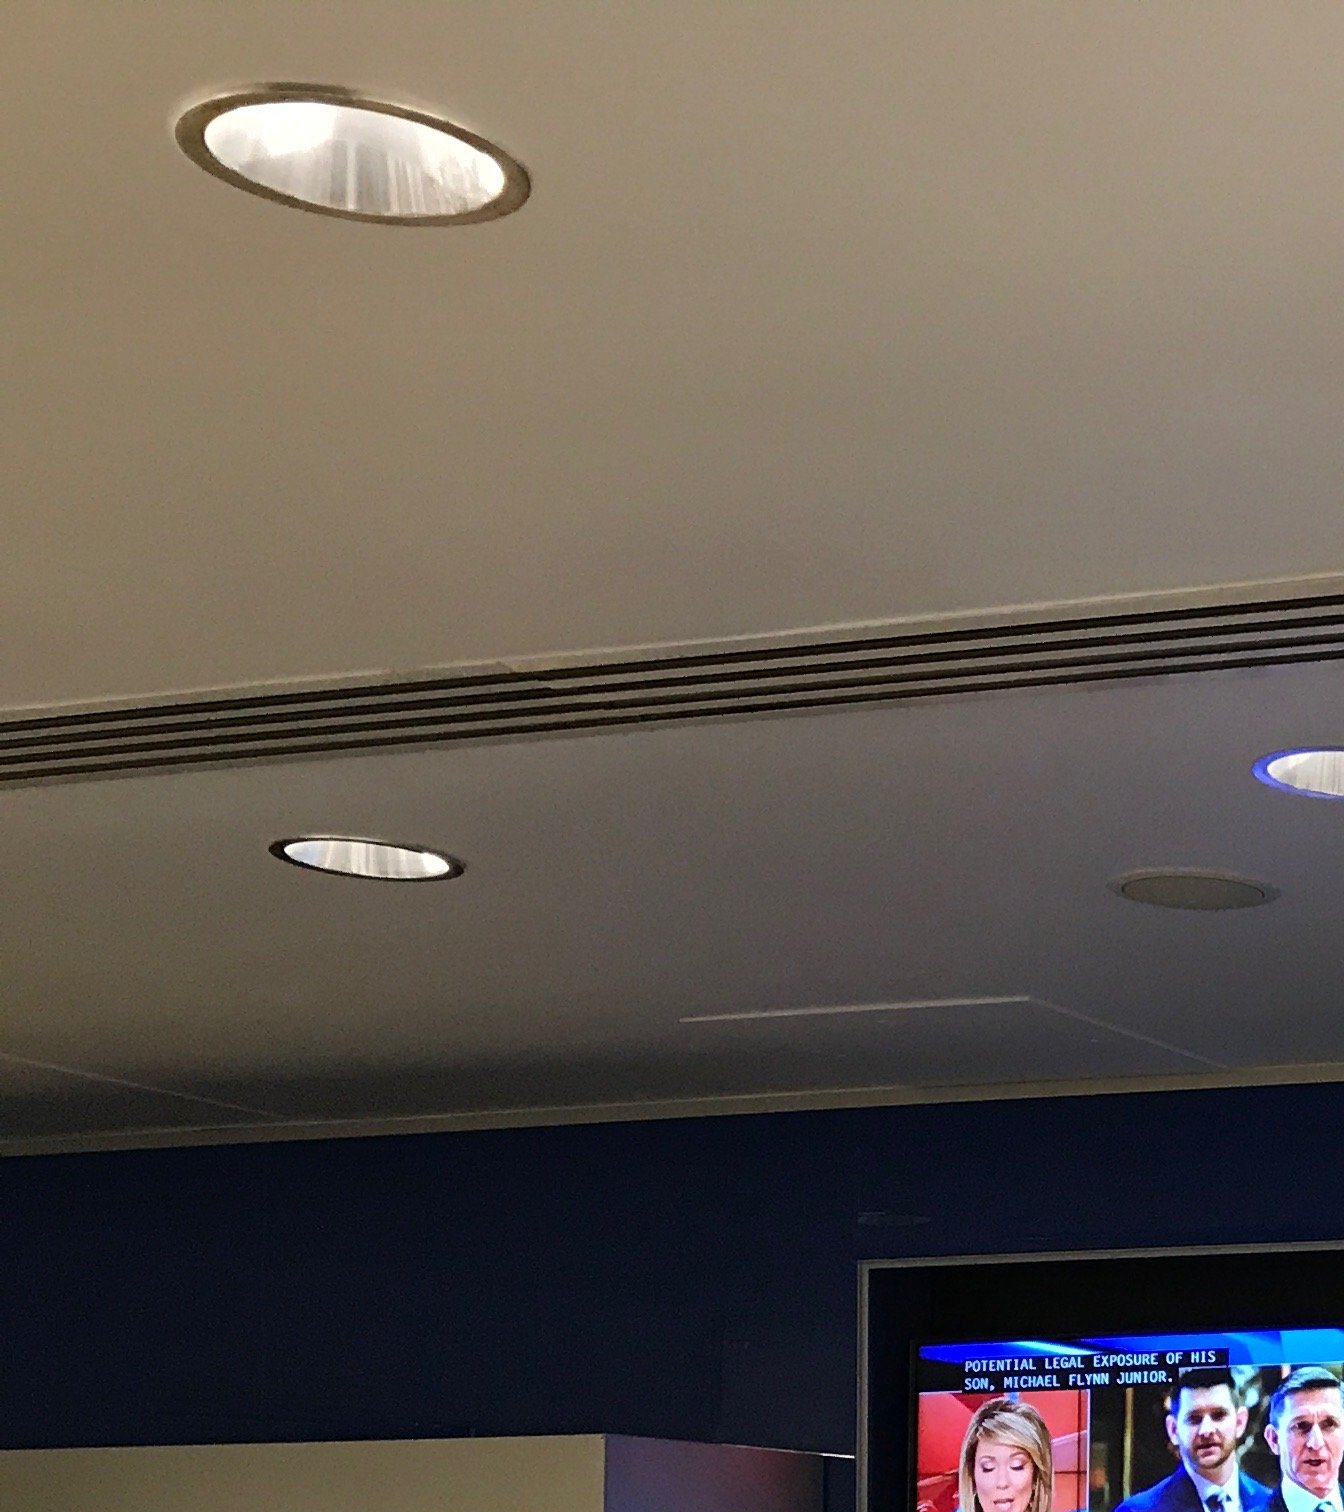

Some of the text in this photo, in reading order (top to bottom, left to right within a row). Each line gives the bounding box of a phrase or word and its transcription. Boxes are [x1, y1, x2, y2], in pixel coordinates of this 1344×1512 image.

[965, 1350, 1216, 1373] POTENTIAL LEGAL EXPOSURE OF HIS
[964, 1371, 1173, 1391] SON, MICHAEL FLYNN JUNIOR.
